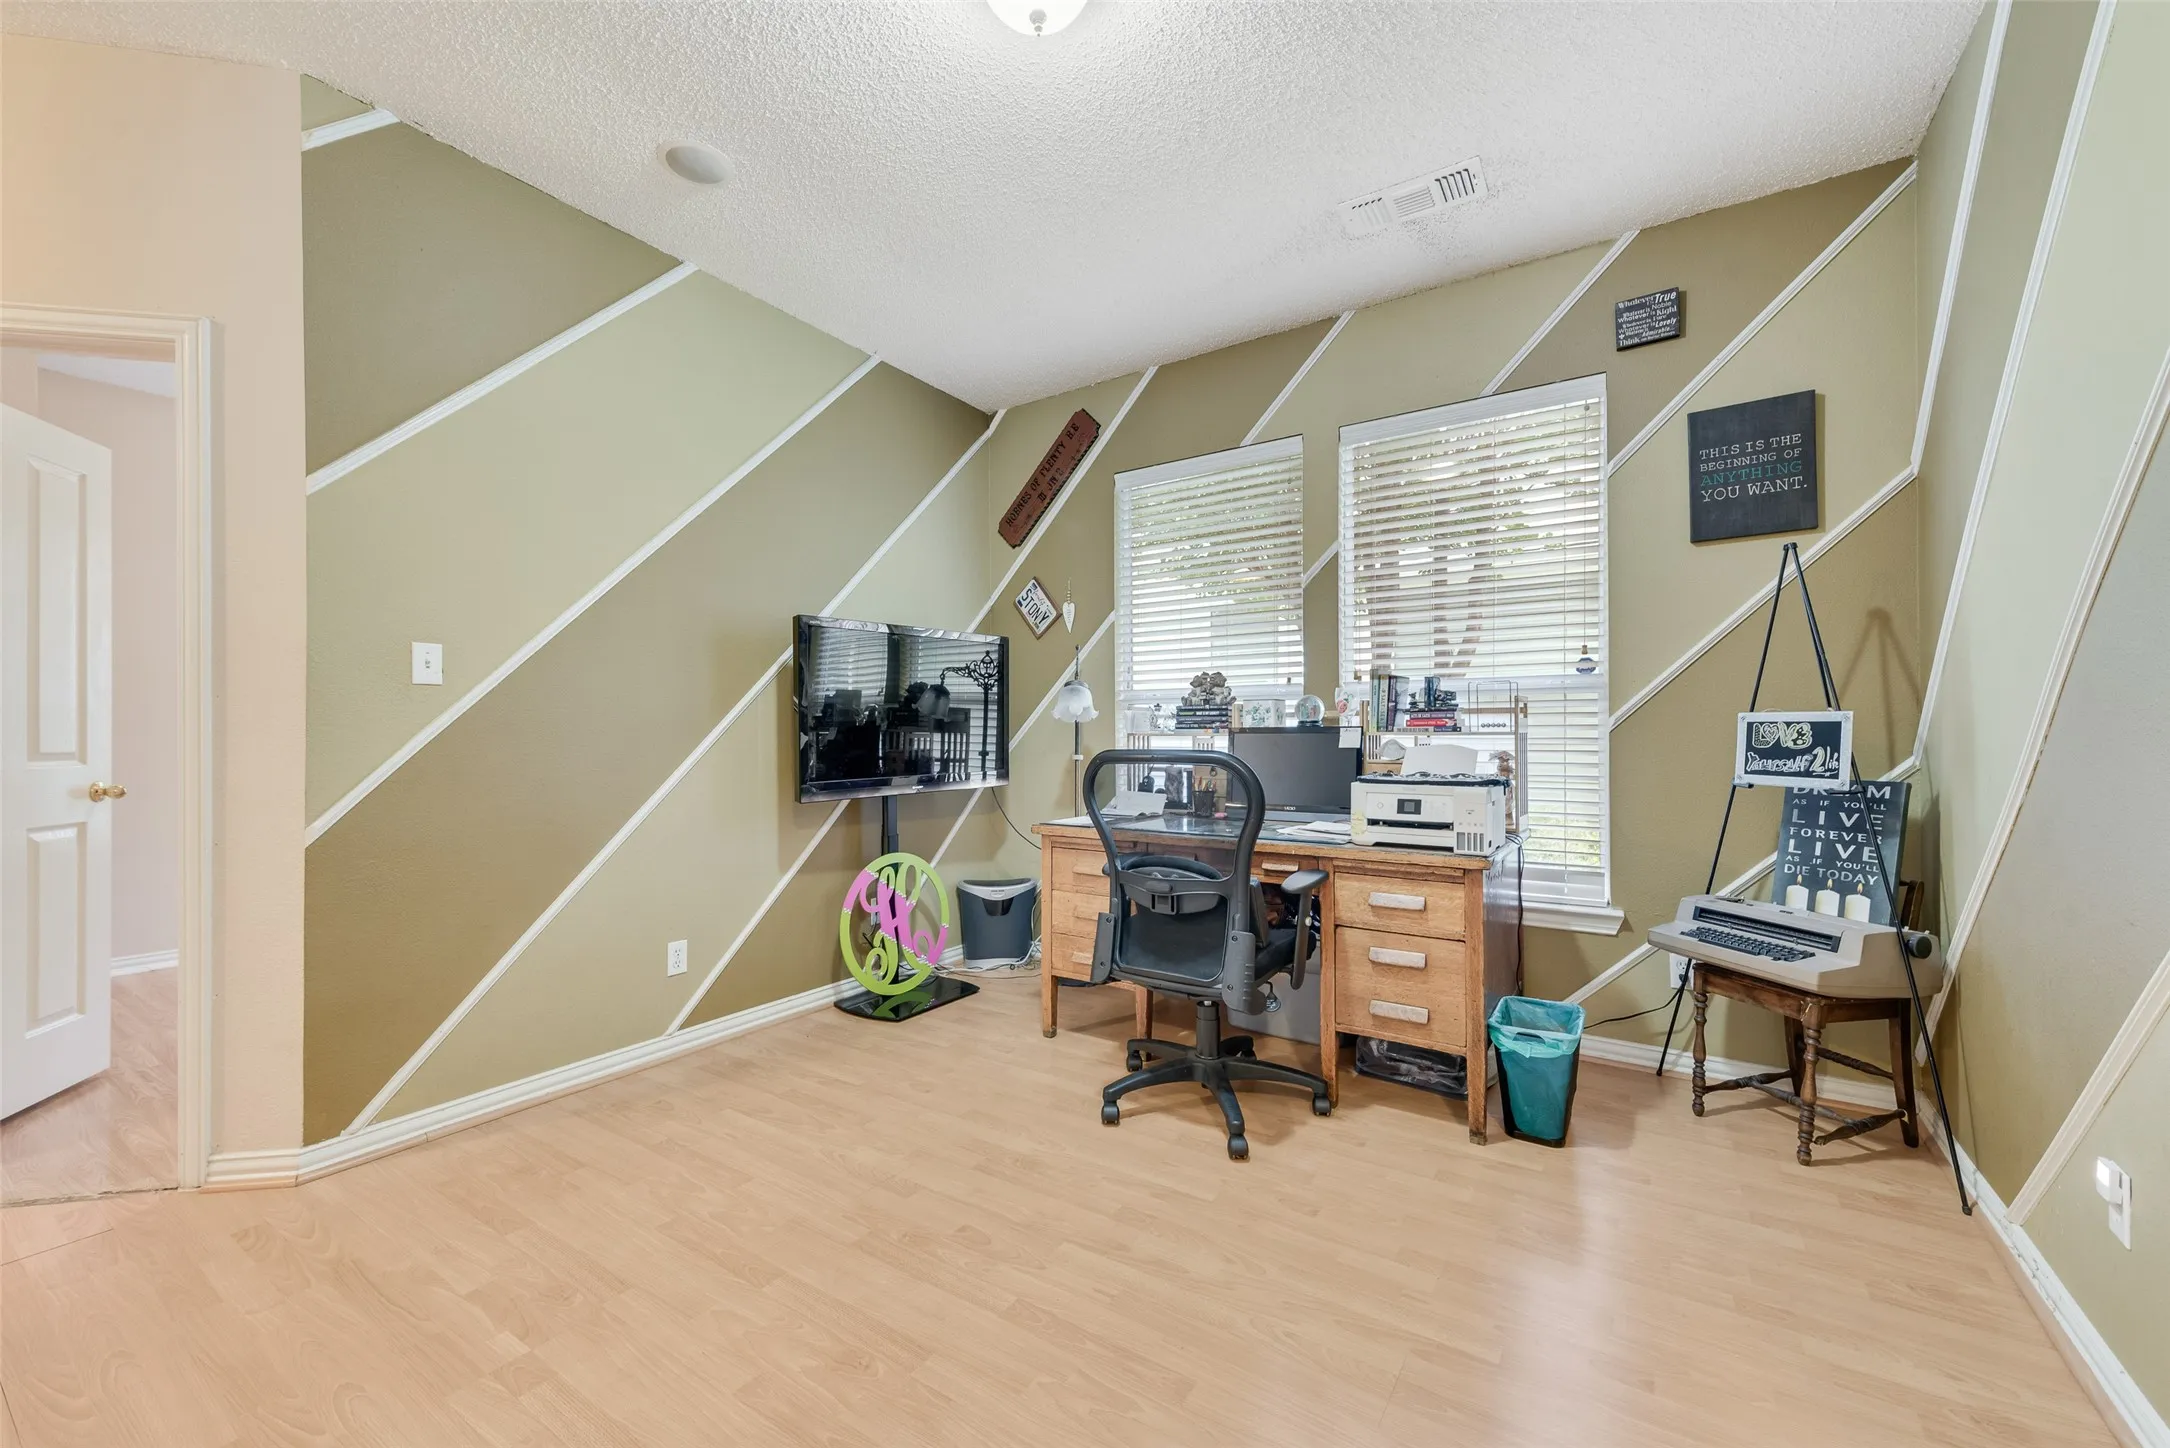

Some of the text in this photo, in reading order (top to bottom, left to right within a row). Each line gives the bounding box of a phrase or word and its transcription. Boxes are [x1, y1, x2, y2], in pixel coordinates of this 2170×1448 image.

[1618, 296, 1654, 309] Whatever
[1655, 291, 1677, 304] True
[1652, 301, 1672, 310] Noble
[1618, 312, 1649, 323] Whatever
[1656, 305, 1677, 316] Right
[1618, 324, 1649, 334] Whatever
[1655, 317, 1677, 327] Lovely
[1620, 337, 1640, 346] Think
[1700, 433, 1802, 460] THIS IS THE
[1030, 477, 1041, 491] OF
[1040, 441, 1066, 477] PLENTY
[1700, 448, 1802, 472] BEGINNING OF
[1700, 460, 1802, 486] ANYTHING
[1701, 476, 1808, 502] YOU WANT.
[1021, 588, 1049, 624] STONY
[1752, 721, 1813, 749] LOVE
[1793, 784, 1891, 799] DRM
[1791, 808, 1884, 830] LIVE
[1788, 838, 1879, 863] LIVE
[1784, 863, 1879, 885] DIE TODAY
[1835, 861, 1880, 873] YOU'LL
